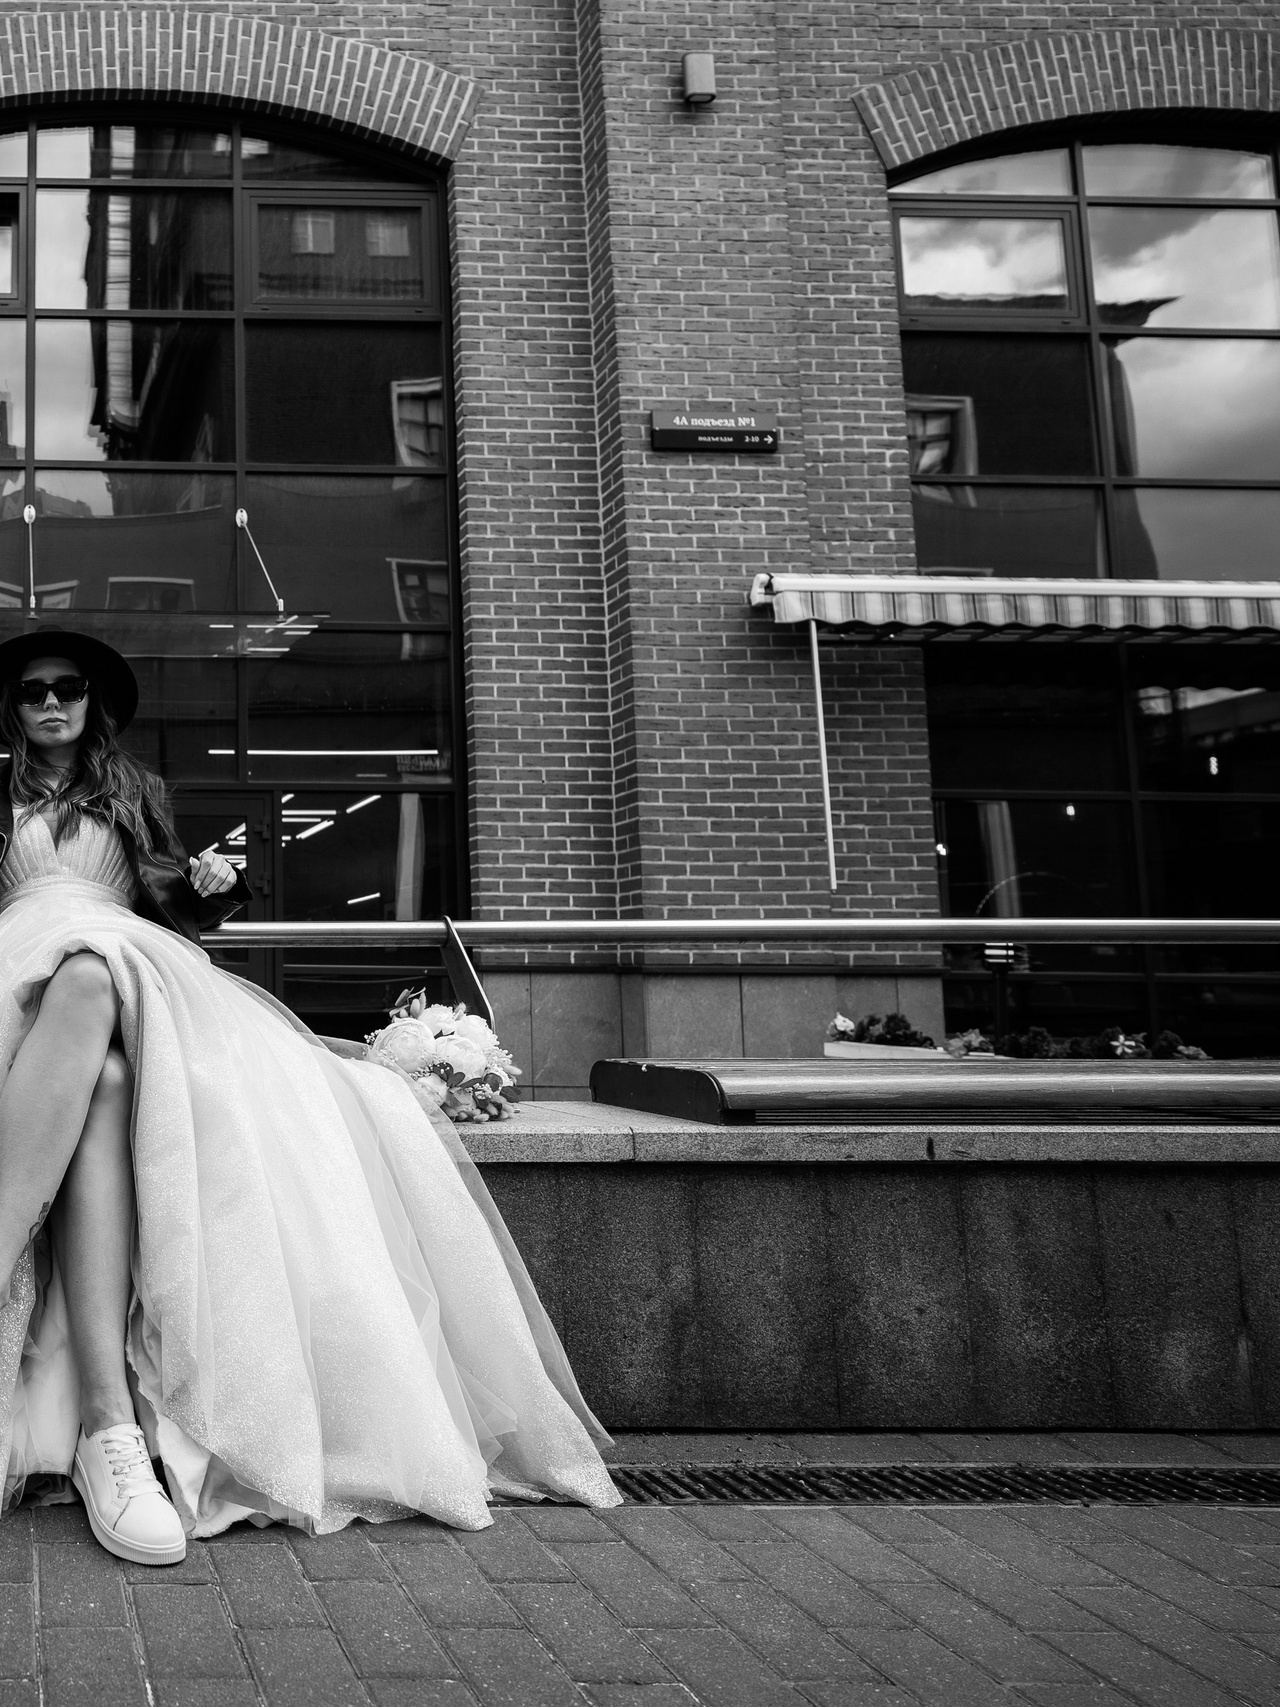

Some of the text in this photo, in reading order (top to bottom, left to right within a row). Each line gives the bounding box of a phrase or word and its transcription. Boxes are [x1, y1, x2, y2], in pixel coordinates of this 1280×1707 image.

[673, 416, 756, 427] 4А подъезд №1
